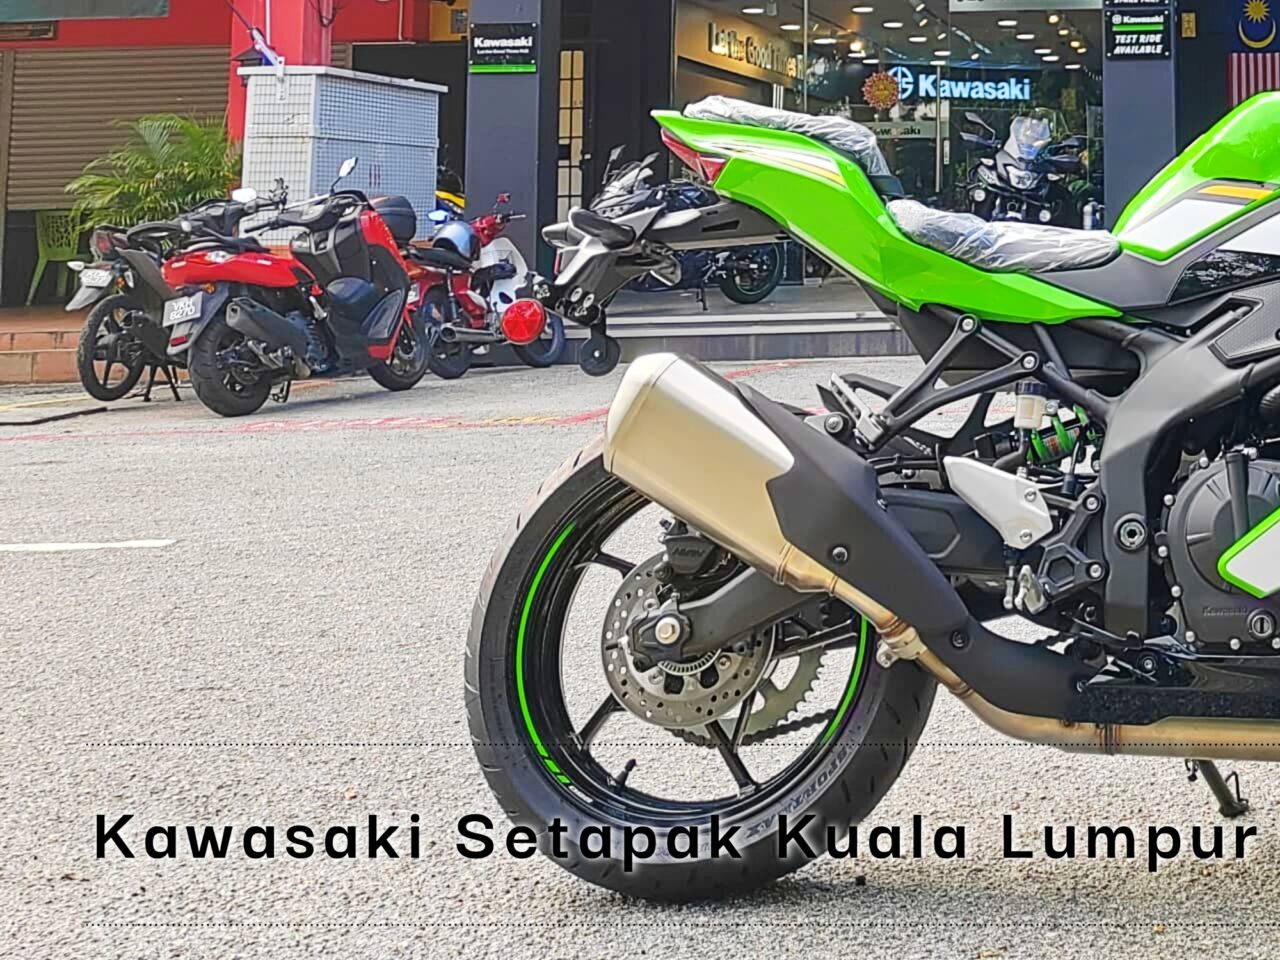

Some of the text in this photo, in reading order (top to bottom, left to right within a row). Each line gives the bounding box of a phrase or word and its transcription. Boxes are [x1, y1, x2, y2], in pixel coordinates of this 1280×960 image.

[1123, 15, 1164, 23] Kawasaki
[474, 36, 533, 48] Kawasaki
[1115, 34, 1162, 44] TEST RIDE
[1113, 45, 1163, 54] AVAILABLE
[918, 74, 1031, 100] Kawasaki
